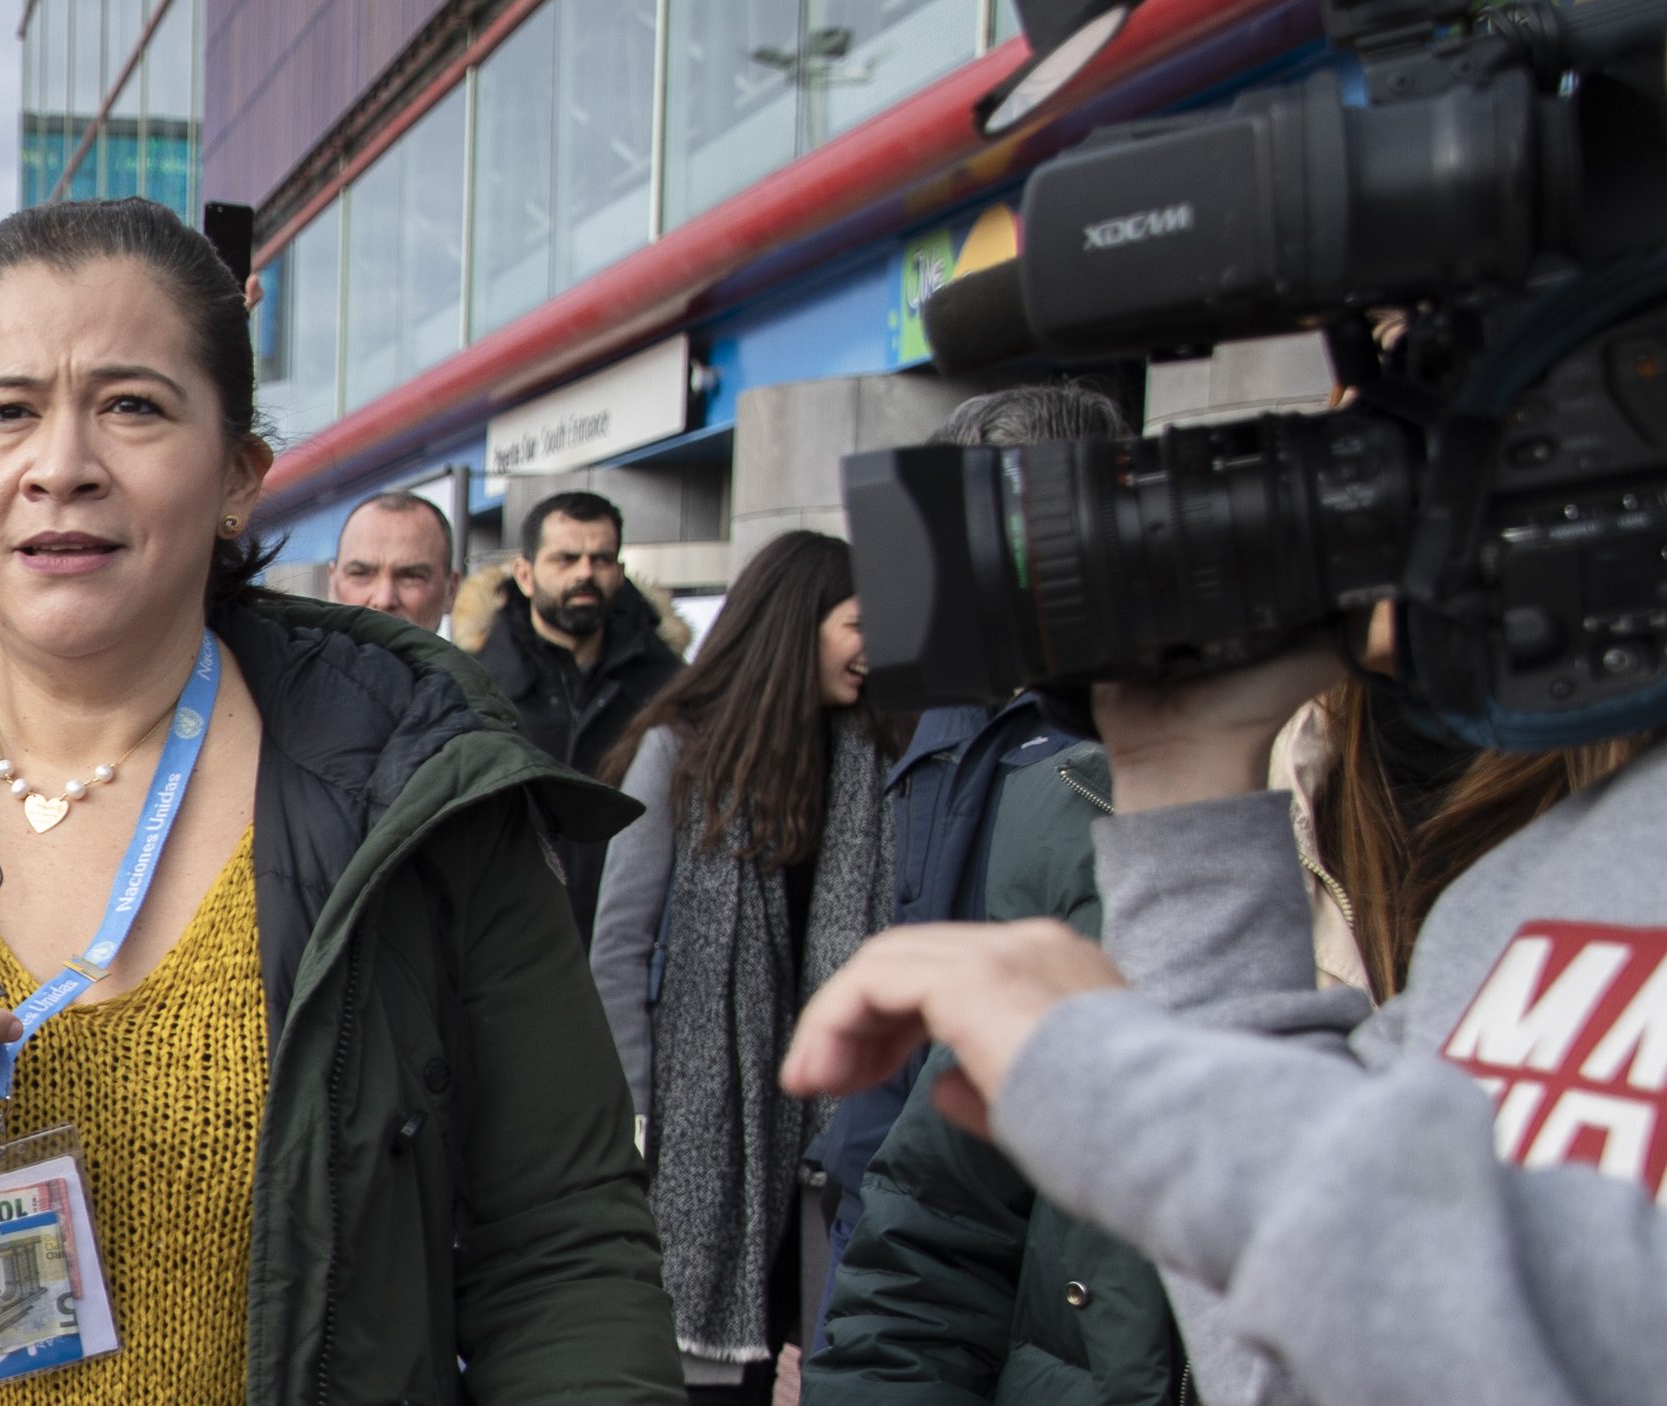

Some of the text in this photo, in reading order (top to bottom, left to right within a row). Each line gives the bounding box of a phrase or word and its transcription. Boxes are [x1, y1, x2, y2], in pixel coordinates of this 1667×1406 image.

[115, 772, 182, 913] Naciones Unidas
[28, 979, 80, 1013] Unidas
